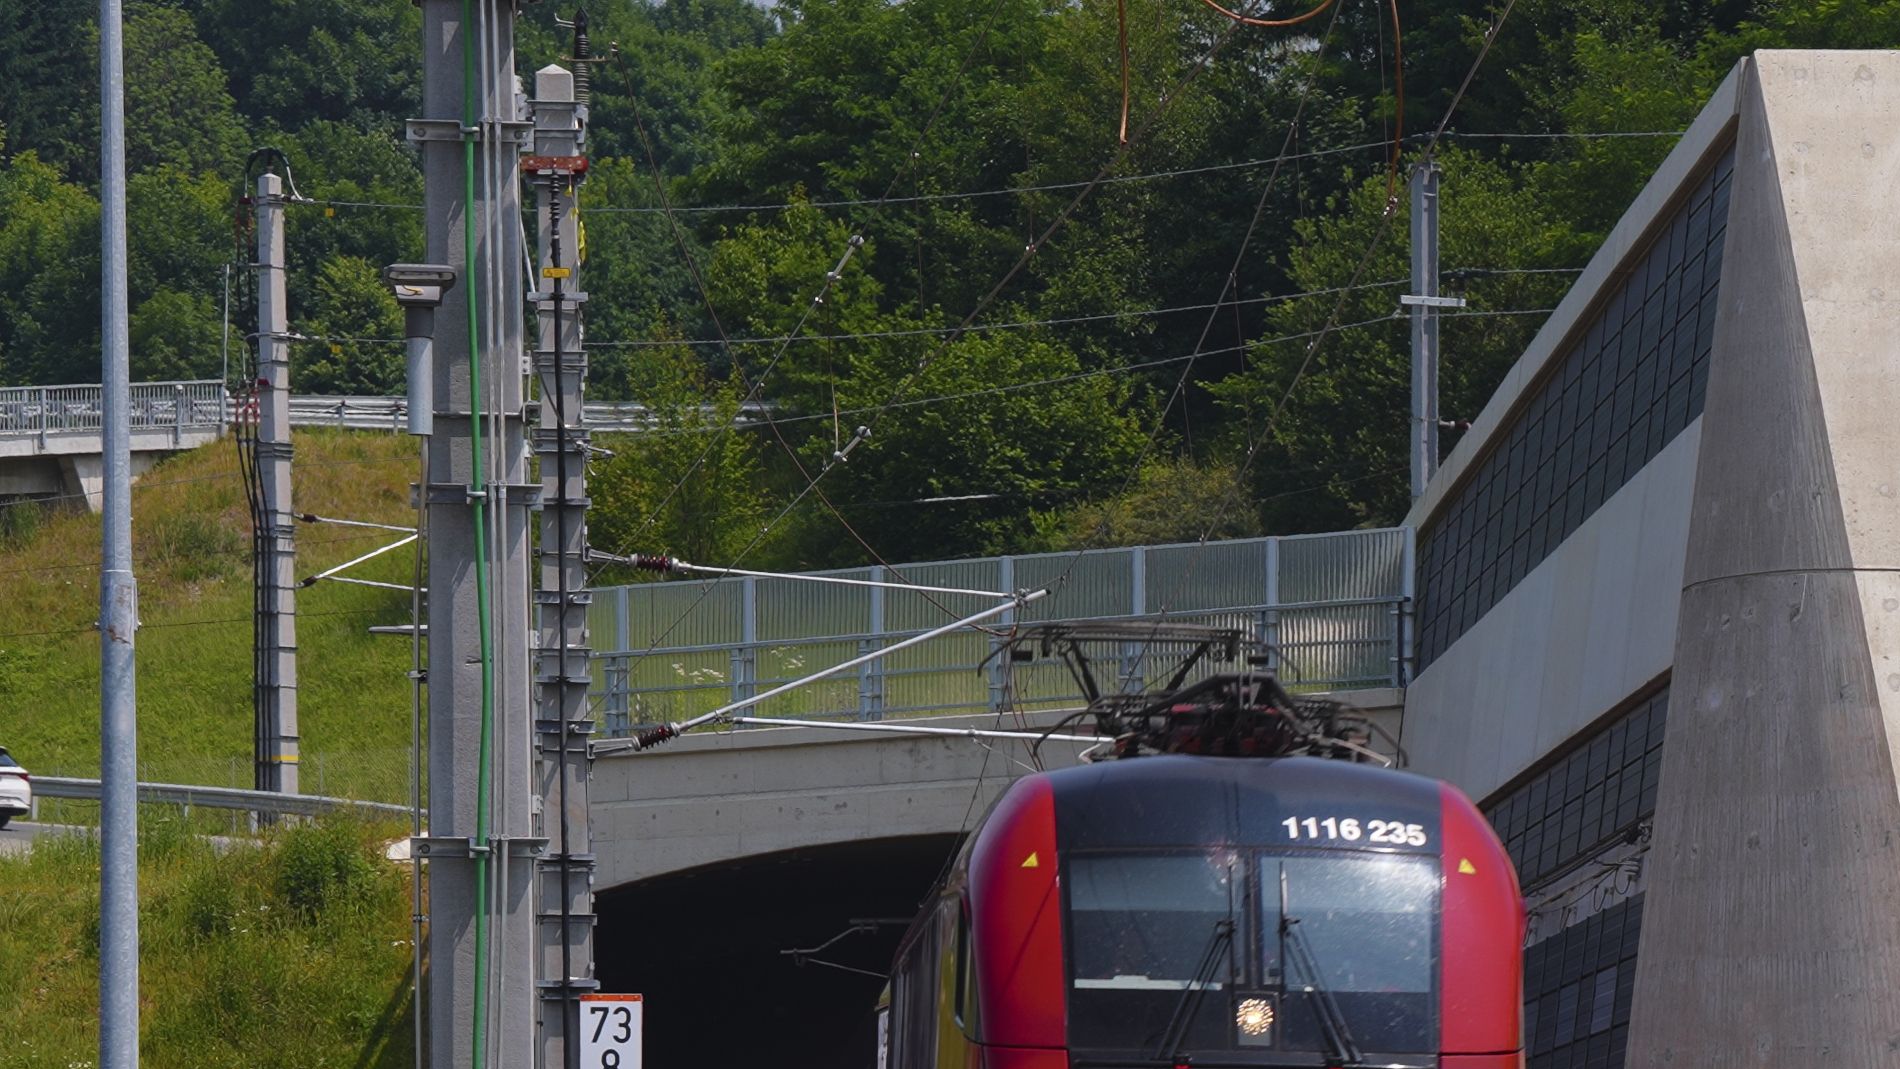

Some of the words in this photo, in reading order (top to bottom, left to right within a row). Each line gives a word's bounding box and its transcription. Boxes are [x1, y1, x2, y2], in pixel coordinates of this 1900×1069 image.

[1282, 816, 1361, 841] 1116
[1367, 819, 1427, 847] 235
[590, 1006, 631, 1044] 73
